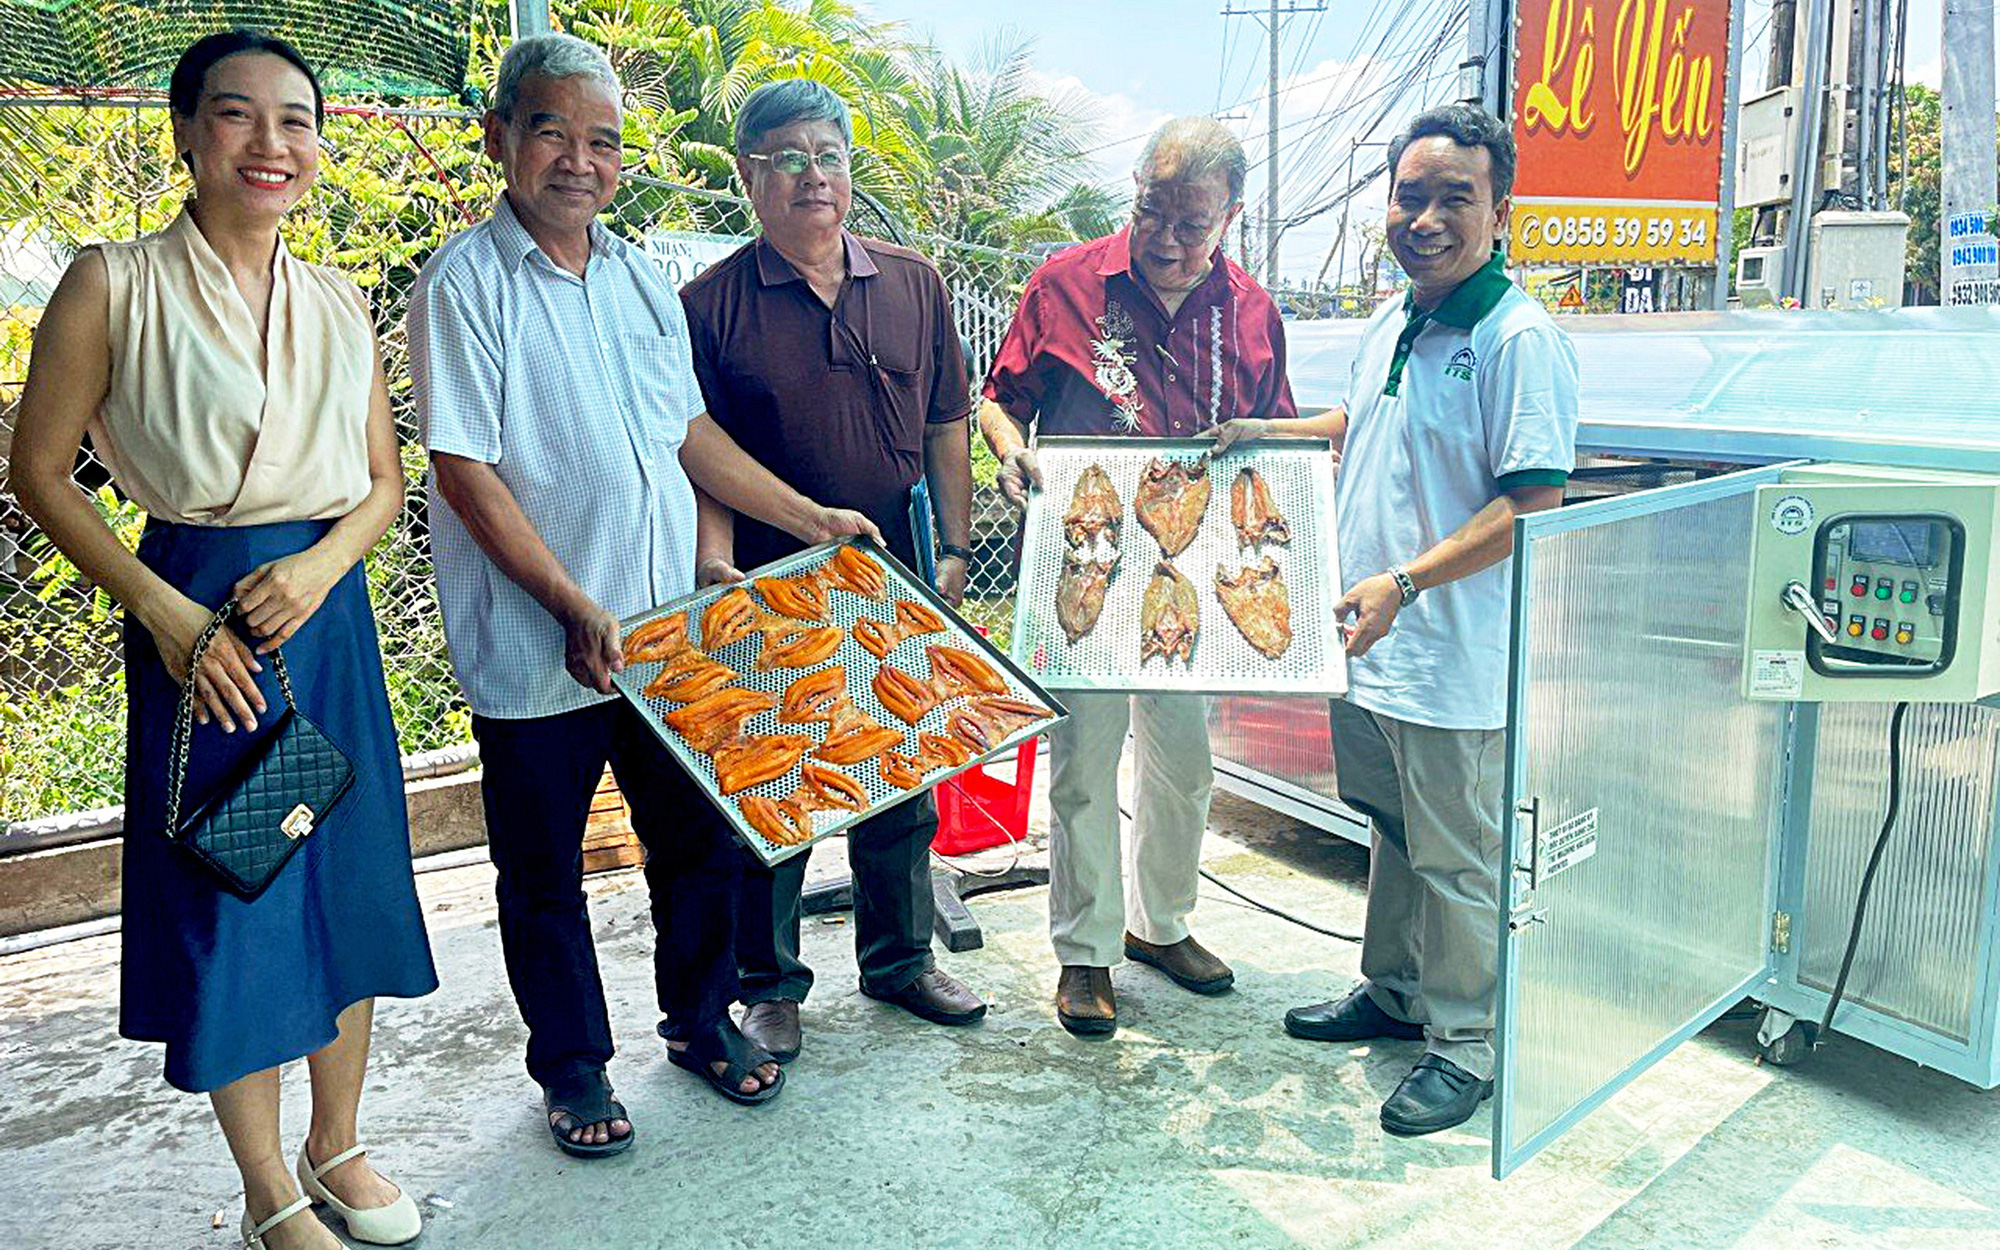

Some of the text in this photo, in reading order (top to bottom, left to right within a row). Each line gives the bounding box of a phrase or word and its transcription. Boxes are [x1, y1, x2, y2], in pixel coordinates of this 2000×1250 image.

[1524, 0, 1713, 173] Lê Yến
[1543, 216, 1706, 247] 0858 39 59 34
